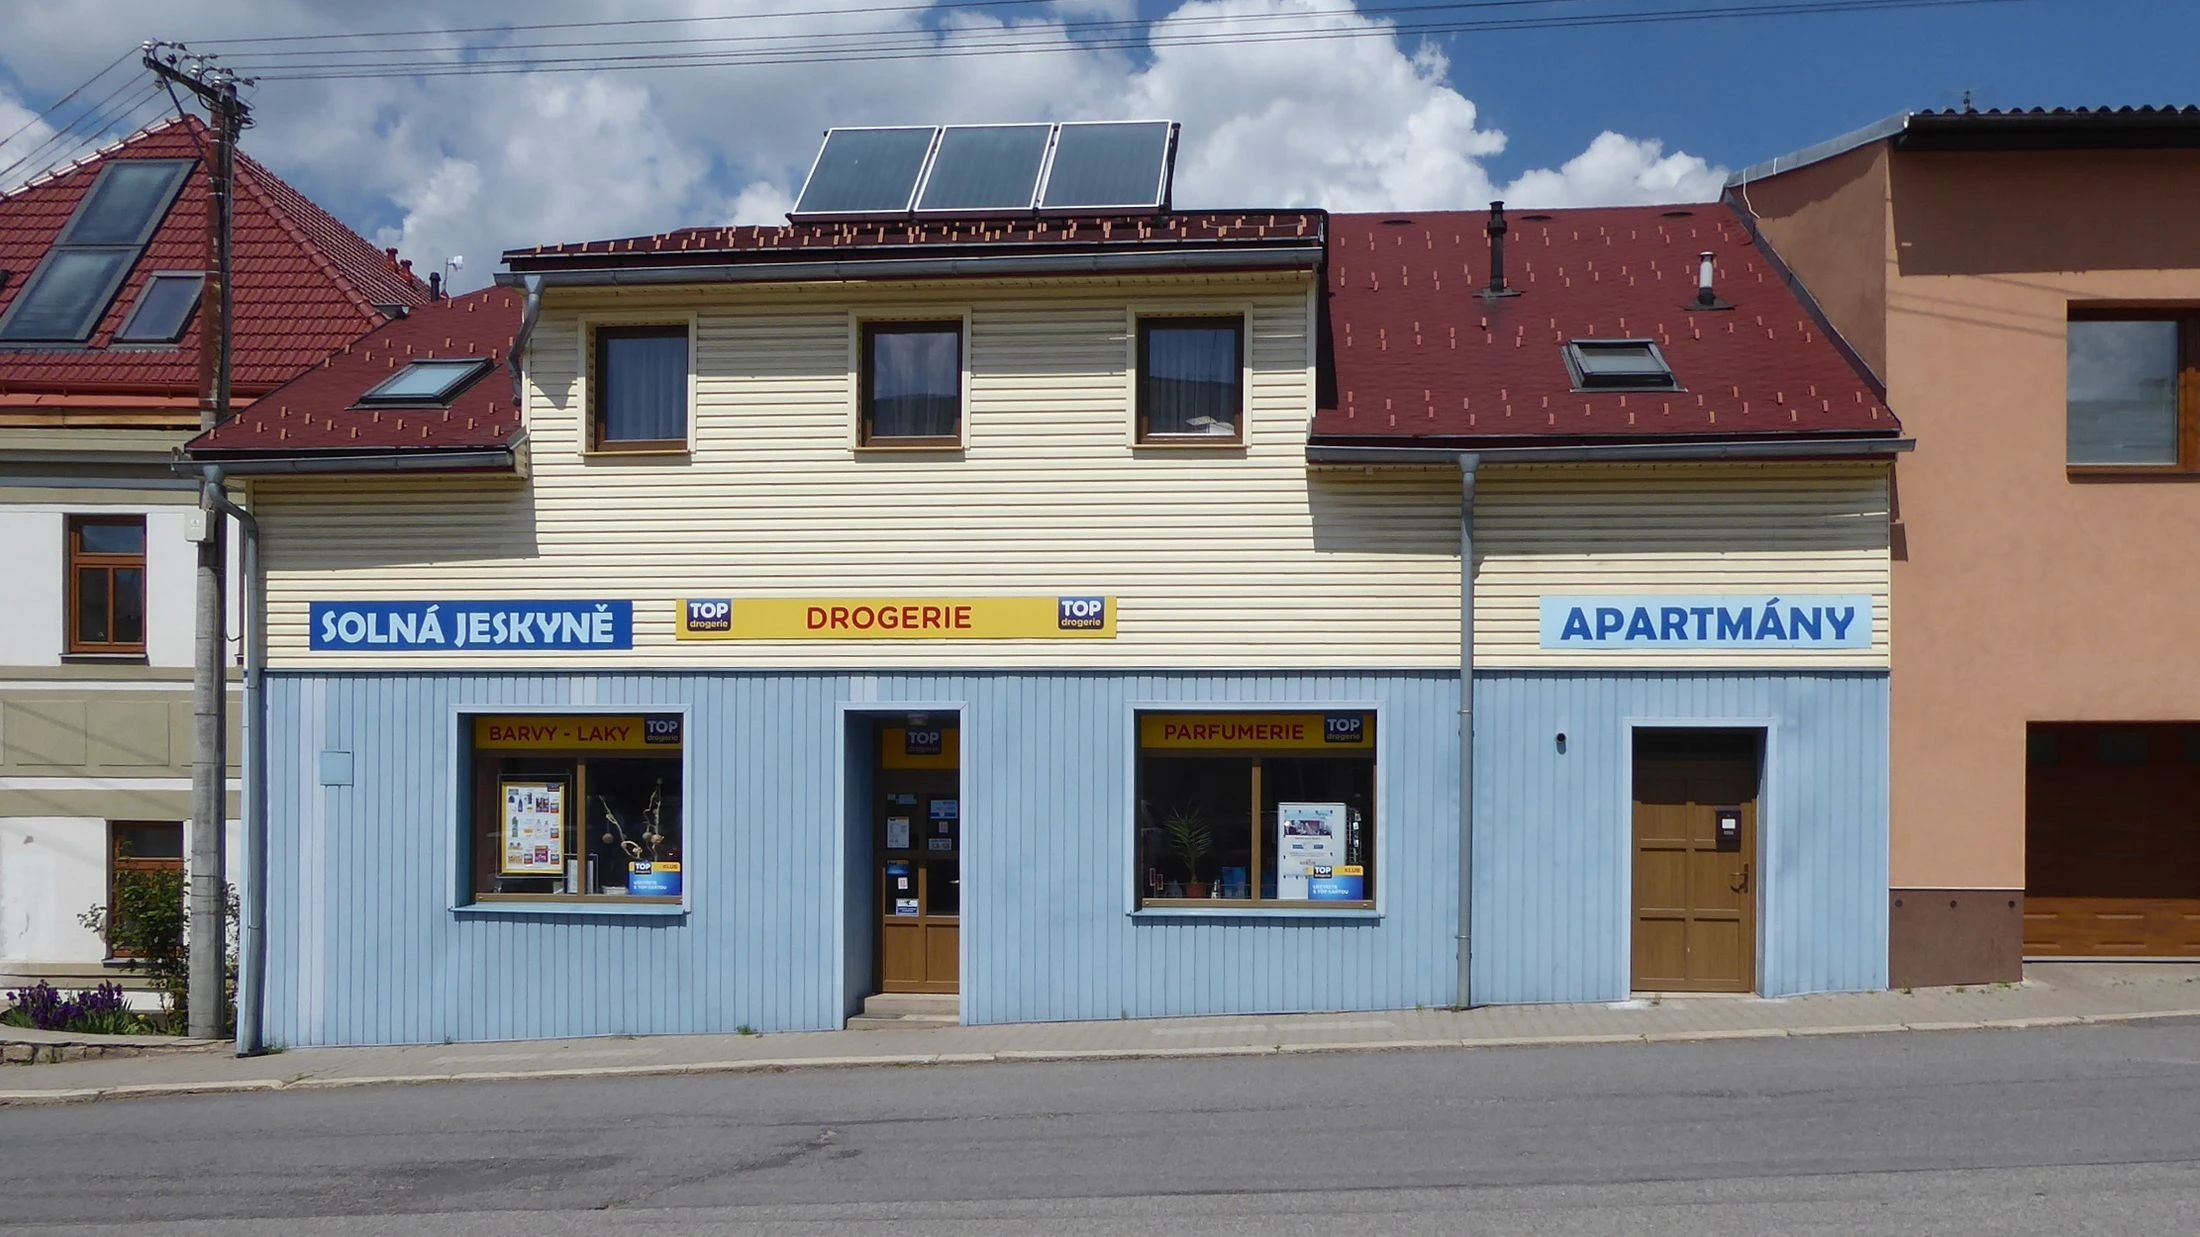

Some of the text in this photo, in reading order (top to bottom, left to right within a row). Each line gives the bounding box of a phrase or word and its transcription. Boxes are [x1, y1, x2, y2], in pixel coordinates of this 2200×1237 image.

[690, 602, 729, 618] TOP
[1061, 600, 1102, 617] TOP
[690, 619, 728, 630] drogerie
[806, 605, 972, 630] DROGERIE
[1061, 617, 1101, 628] drogerie
[1560, 597, 1855, 641] APARTMÁNY
[322, 603, 614, 648] SOLNÁ JESKYNĚ
[646, 719, 679, 733] TOP
[1164, 723, 1305, 740] PARFUMERIE
[1327, 718, 1361, 732] TOP
[489, 726, 557, 741] BARVY
[577, 726, 631, 741] LAKY
[908, 732, 940, 744] TOP
[635, 862, 651, 871] TOP
[1314, 866, 1332, 874] TOP
